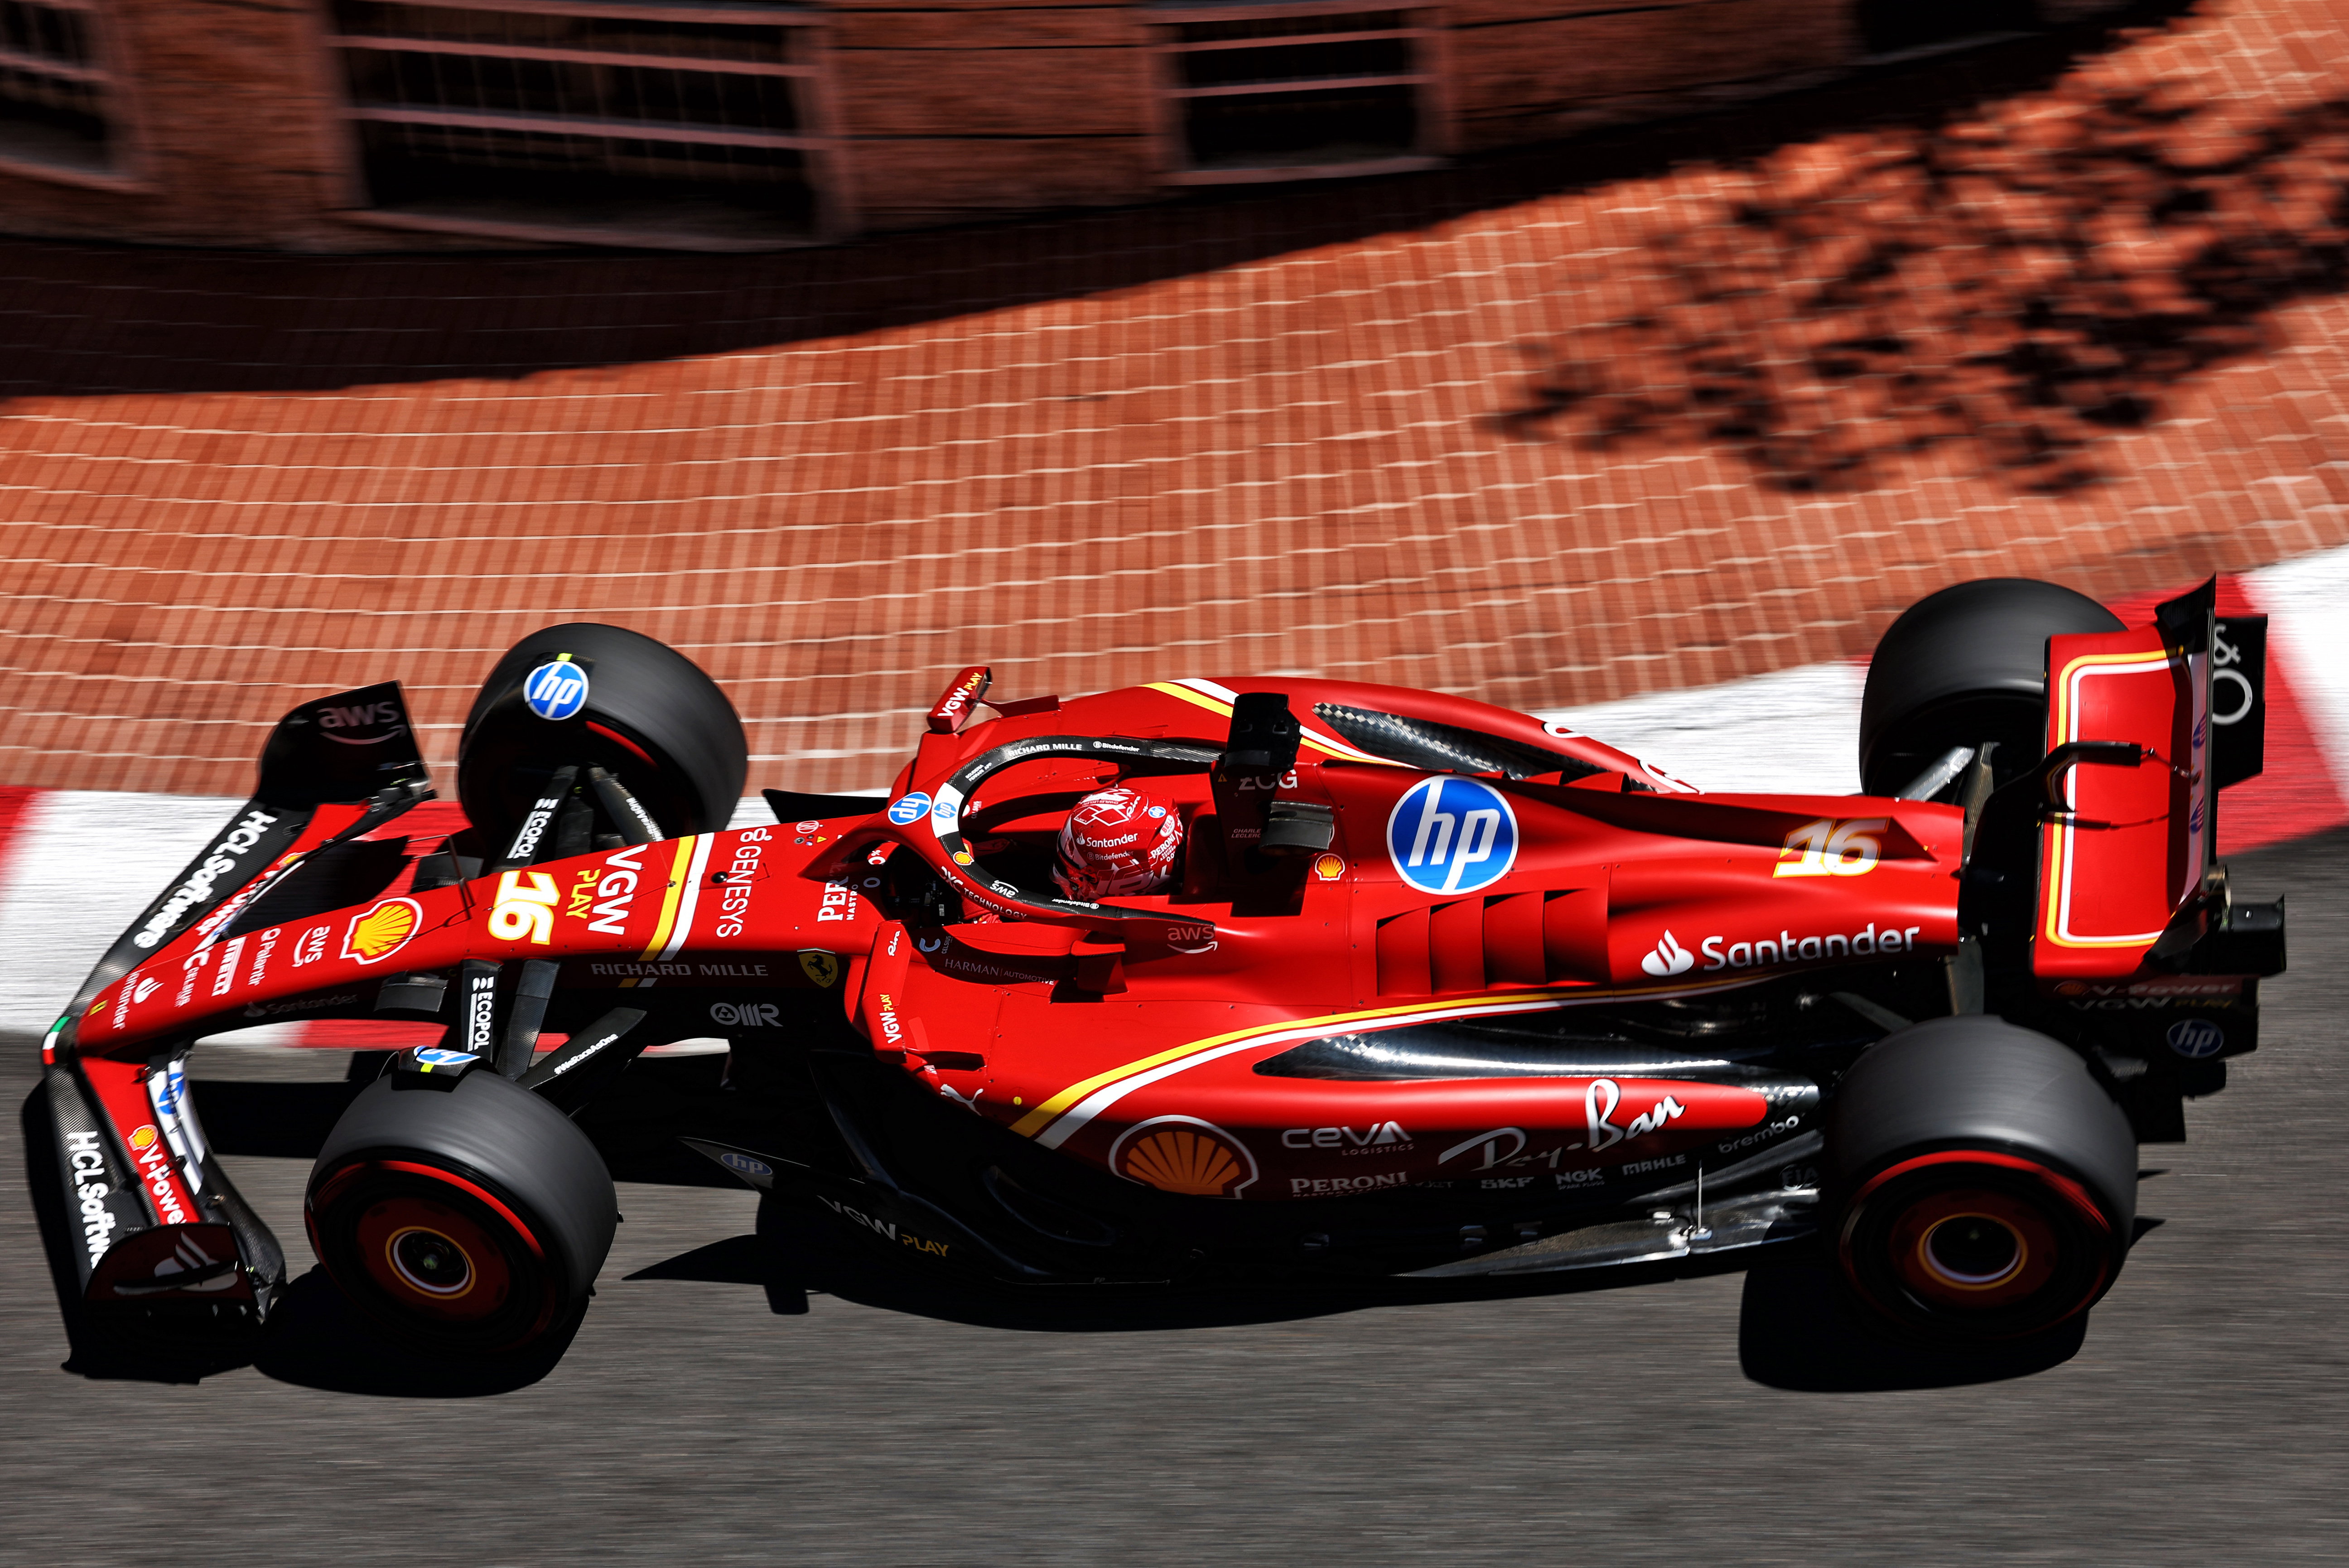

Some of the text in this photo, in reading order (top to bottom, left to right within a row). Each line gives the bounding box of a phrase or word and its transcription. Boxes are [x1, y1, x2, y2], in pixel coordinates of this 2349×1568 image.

[532, 661, 582, 719] hp
[937, 672, 983, 717] VGW PLAY
[316, 701, 401, 729] aws
[1008, 743, 1050, 757] RICHARD
[1102, 742, 1140, 753] Bitdefender
[890, 796, 930, 820] hp
[933, 803, 956, 818] hp
[1127, 796, 1141, 818] Riva
[513, 811, 552, 859] ECOPOL
[1162, 818, 1173, 833] BELL
[1408, 775, 1500, 894] hp
[1086, 833, 1138, 848] Santander
[1150, 833, 1176, 859] PERONI
[1772, 817, 1890, 878] 16
[1095, 850, 1134, 861] Bitdefender
[566, 869, 601, 919] PLAY
[588, 844, 648, 935] VGW
[716, 845, 762, 937] GENESYS
[817, 876, 849, 922] PER
[846, 884, 859, 921] NASTRO
[964, 888, 1027, 919] TECHNOLOGY
[989, 883, 1016, 898] aws
[1052, 898, 1090, 909] Bitdefender
[487, 870, 561, 945] 16
[304, 926, 330, 964] aws
[888, 931, 901, 956] Riva
[941, 935, 951, 954] CELSIUS
[1167, 926, 1215, 941] aws
[1701, 922, 1920, 971] Santander
[211, 936, 247, 997] PIRELLI
[248, 940, 276, 986] Palantir
[591, 964, 768, 976] RICHARD MILLE
[945, 958, 1055, 985] HARMAN AUTOMOTIVE
[2068, 997, 2173, 1011] VGW
[474, 992, 493, 1050] ECOPOL
[880, 994, 902, 1044] VGW PLAY
[2176, 1019, 2217, 1057] hp
[554, 1033, 618, 1075] #WeRaceAsOne
[1438, 1078, 1687, 1172] Ray-Ban
[1717, 1115, 1799, 1154] brembo
[730, 1153, 765, 1174] hp
[1342, 1142, 1415, 1156] LOGISTICS
[1554, 1167, 1603, 1185] NGK
[1622, 1153, 1687, 1176] MAHLE
[1289, 1171, 1408, 1194] PERONI
[1481, 1177, 1535, 1189] SKF
[67, 1130, 116, 1269] HCLSoftw
[817, 1195, 949, 1257] VGW PLAY
